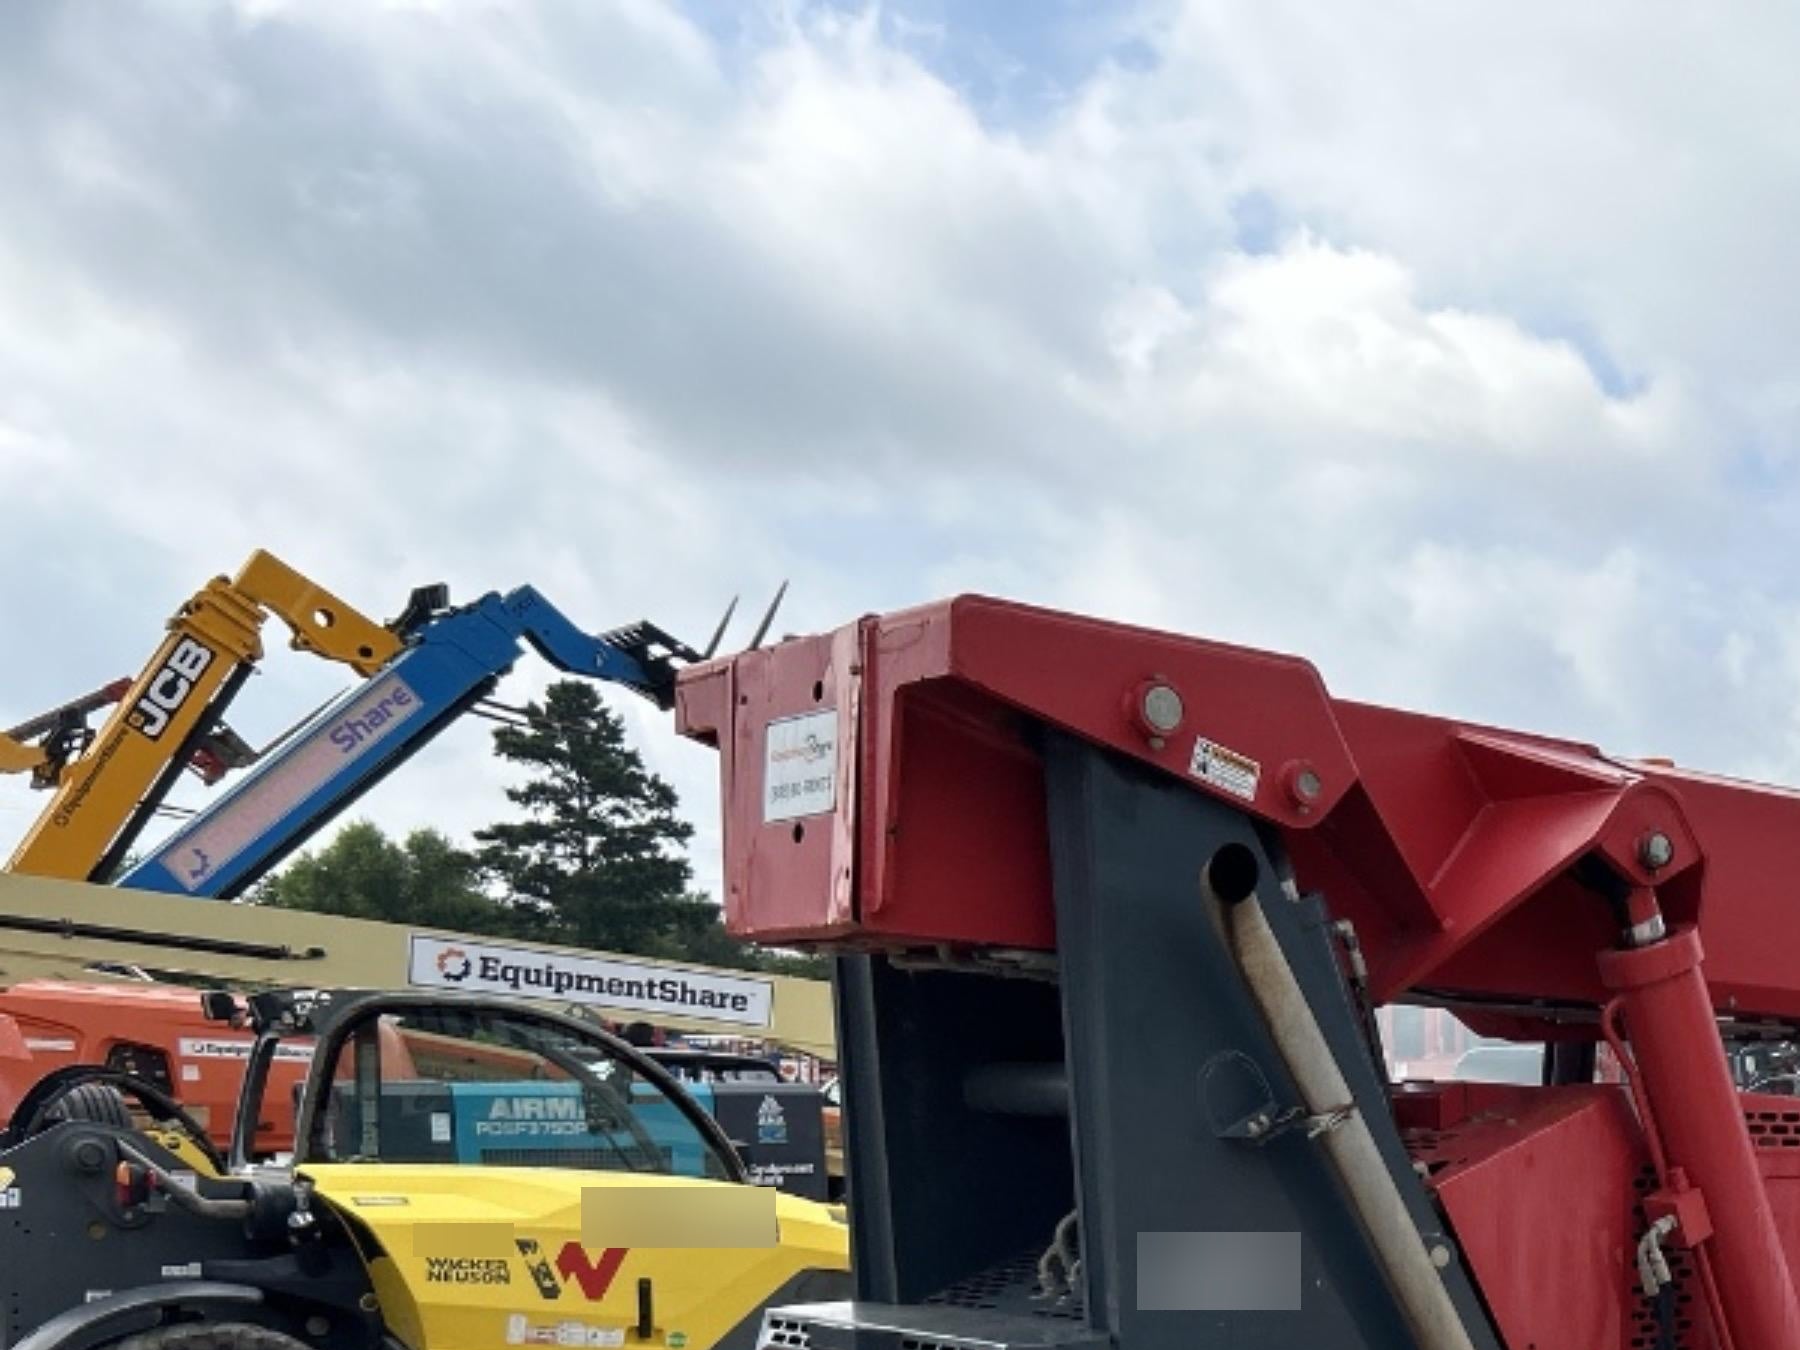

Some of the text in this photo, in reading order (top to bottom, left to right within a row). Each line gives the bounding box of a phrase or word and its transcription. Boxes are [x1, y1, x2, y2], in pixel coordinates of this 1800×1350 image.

[138, 638, 212, 737] JCB
[329, 686, 412, 752] Share
[478, 956, 748, 1012] EquipmentShare
[488, 1097, 586, 1120] AIRM
